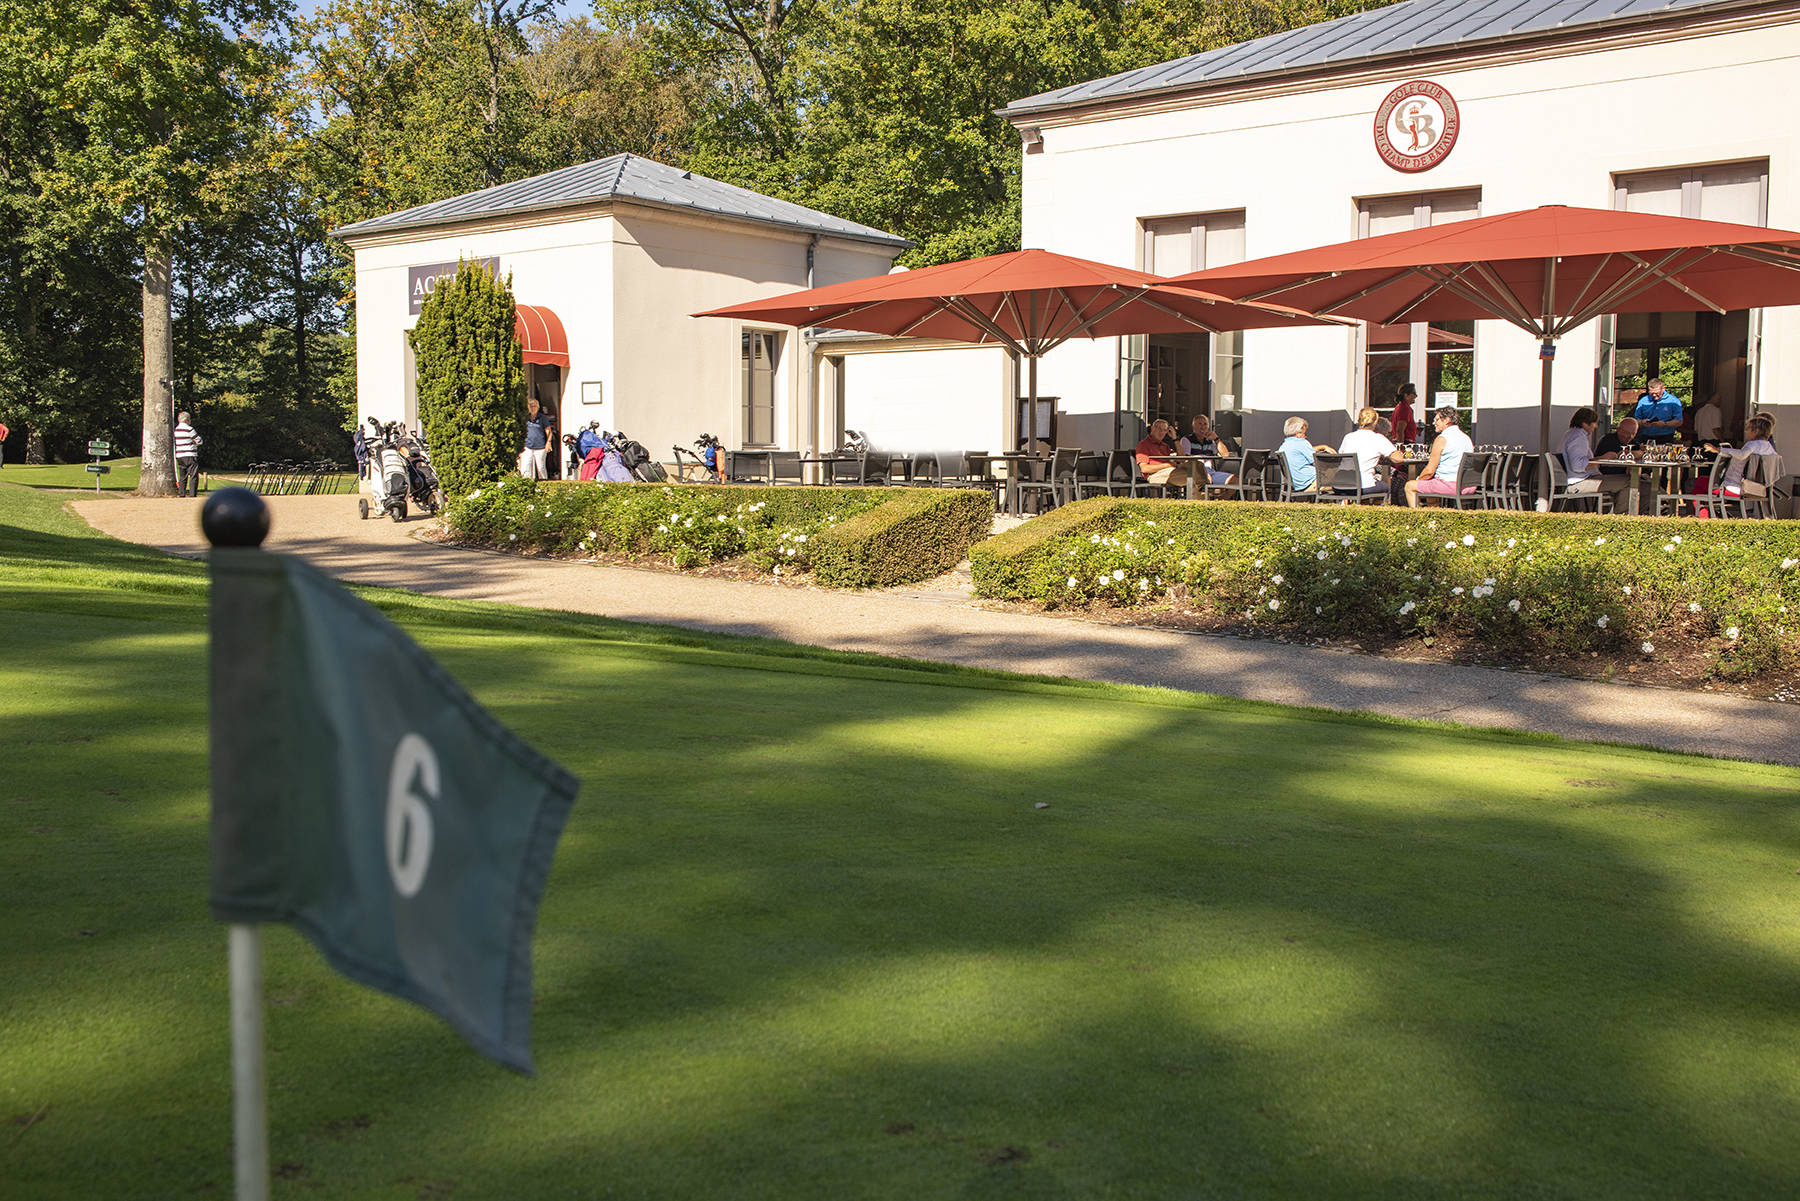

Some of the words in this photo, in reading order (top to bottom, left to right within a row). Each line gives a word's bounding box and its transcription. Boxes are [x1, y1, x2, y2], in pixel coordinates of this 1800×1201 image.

[1389, 84, 1414, 104] GOLF
[1417, 83, 1443, 99] CLUB
[1380, 142, 1410, 167] CHAMP
[1413, 158, 1427, 168] DE
[386, 732, 441, 898] 6
